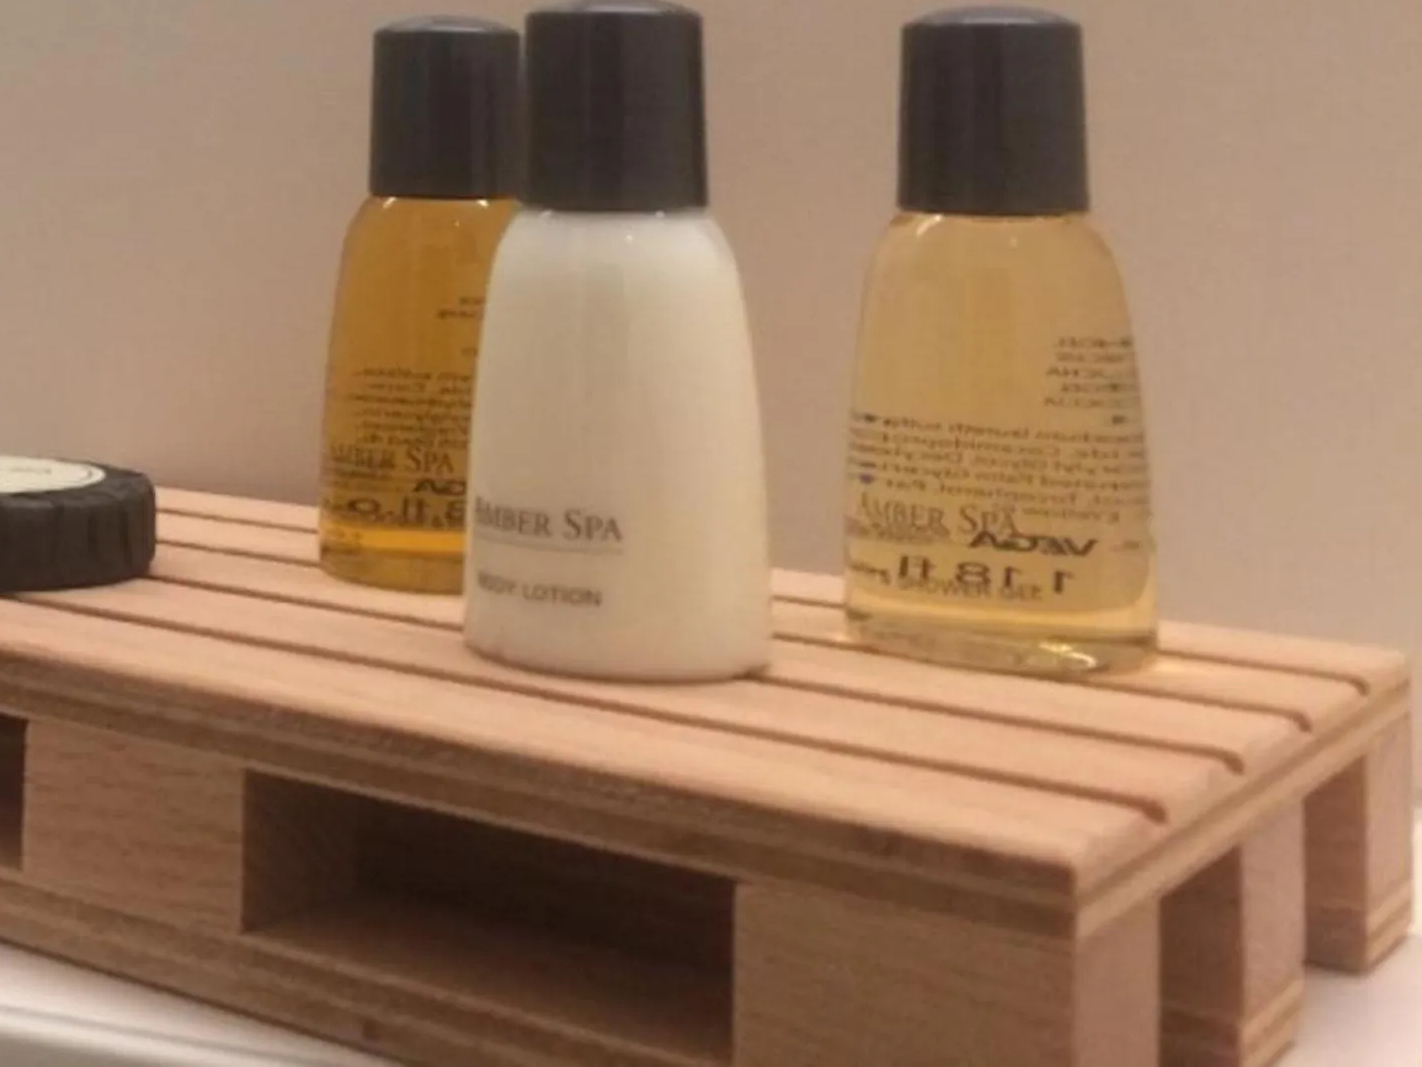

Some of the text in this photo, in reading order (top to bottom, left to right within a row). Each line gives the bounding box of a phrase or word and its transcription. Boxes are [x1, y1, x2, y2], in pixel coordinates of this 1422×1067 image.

[406, 445, 455, 474] SPA
[563, 508, 624, 542] SPA
[957, 503, 1018, 536] SPA
[522, 584, 603, 607] LOTION
